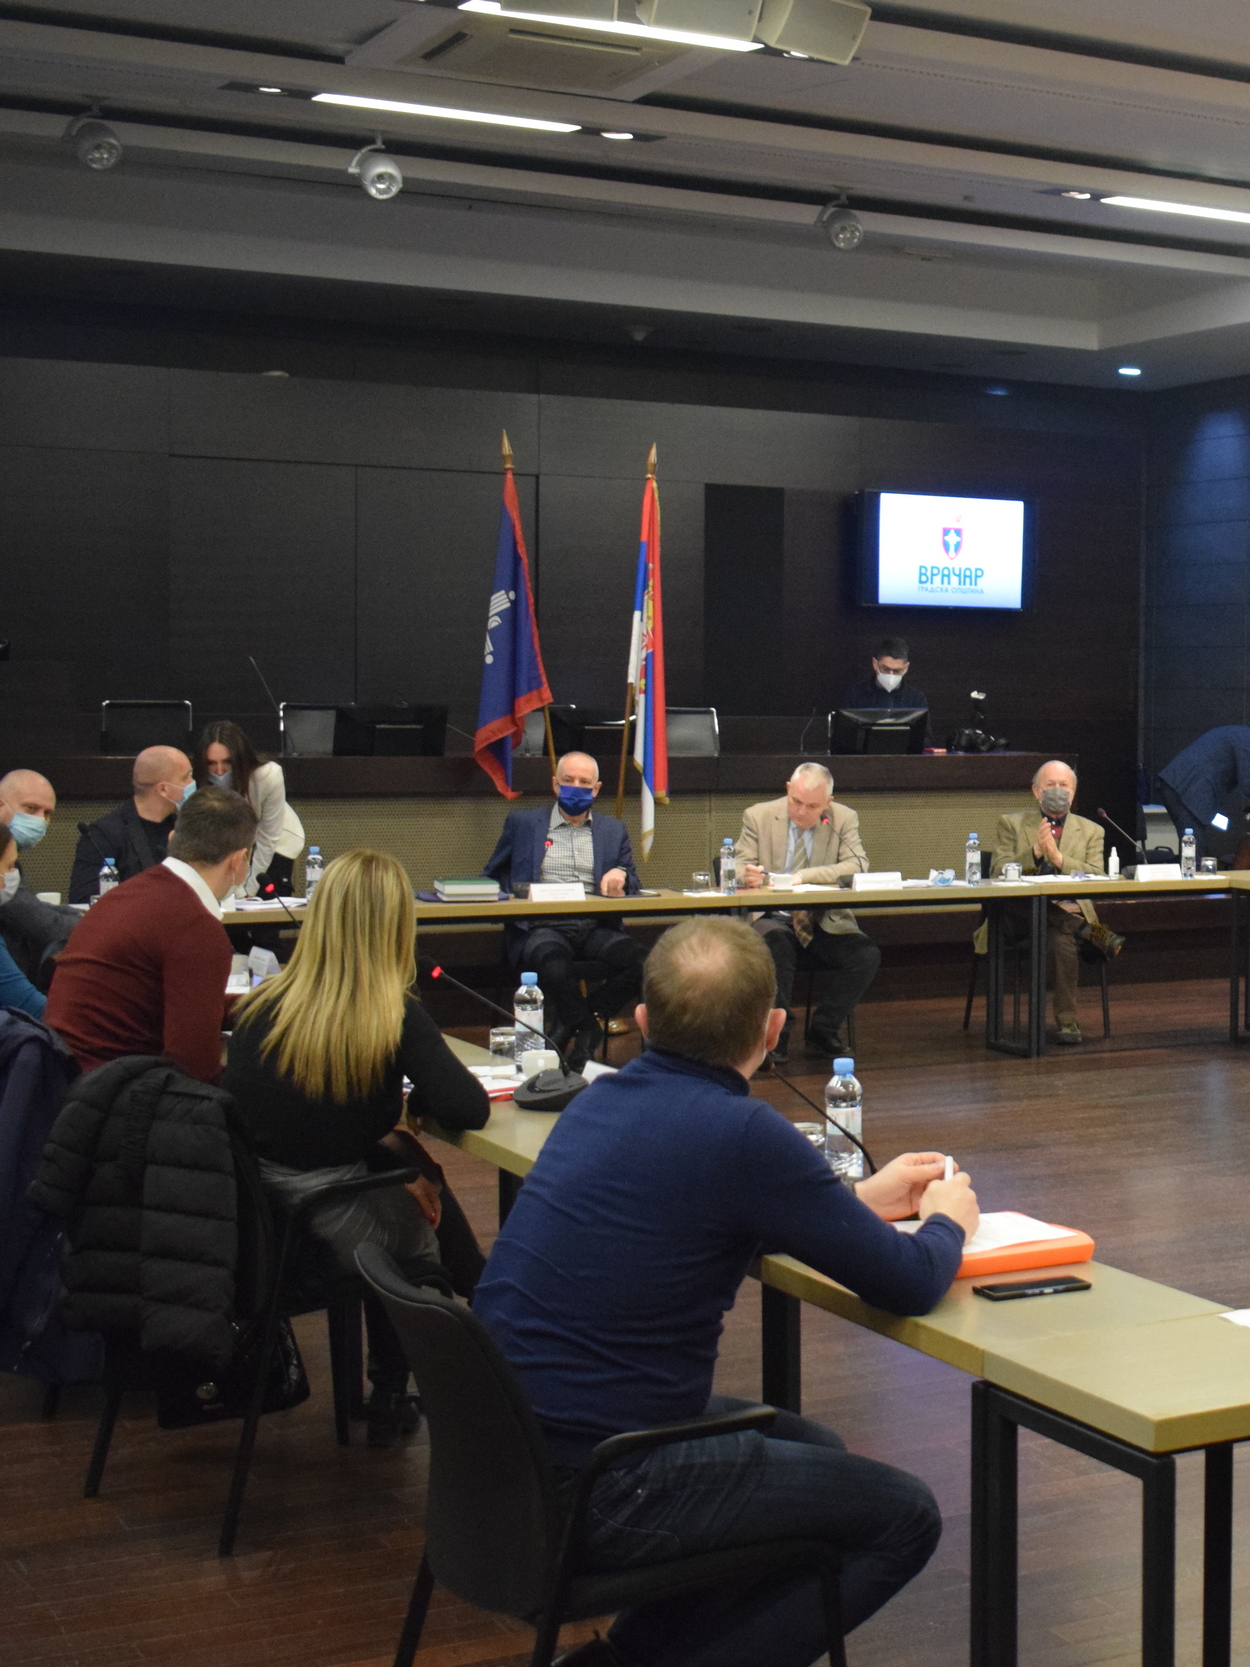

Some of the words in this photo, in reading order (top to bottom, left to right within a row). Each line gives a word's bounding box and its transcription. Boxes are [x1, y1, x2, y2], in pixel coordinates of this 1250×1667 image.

[918, 565, 984, 586] ВРАЧАР
[918, 586, 949, 594] ГРАДСКА
[951, 587, 984, 595] ОПШТИНА
